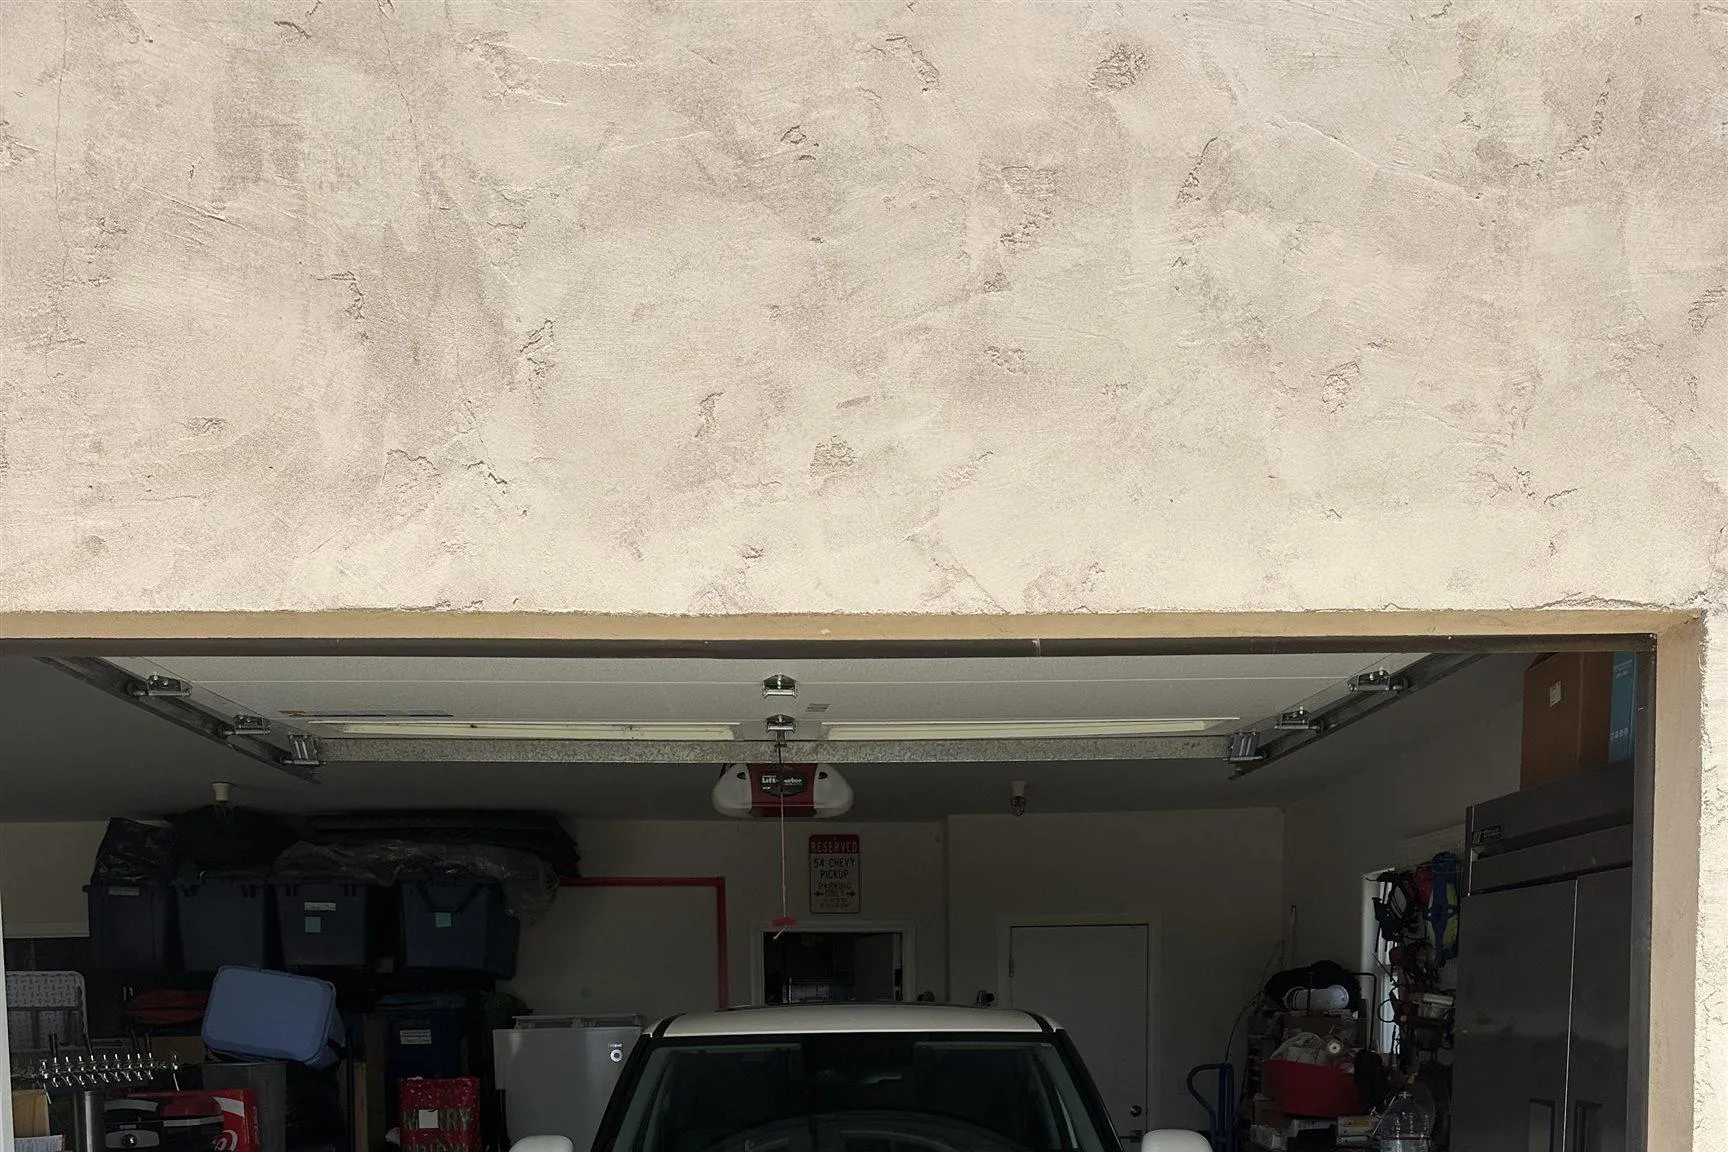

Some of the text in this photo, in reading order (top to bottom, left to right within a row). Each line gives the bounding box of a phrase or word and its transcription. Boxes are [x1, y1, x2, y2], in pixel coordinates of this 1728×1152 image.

[811, 841, 858, 853] RESERVED
[813, 857, 855, 868] 54 CHEVY
[820, 869, 849, 880] PICKUP
[817, 882, 852, 890] PARKING
[824, 889, 845, 897] ONLY
